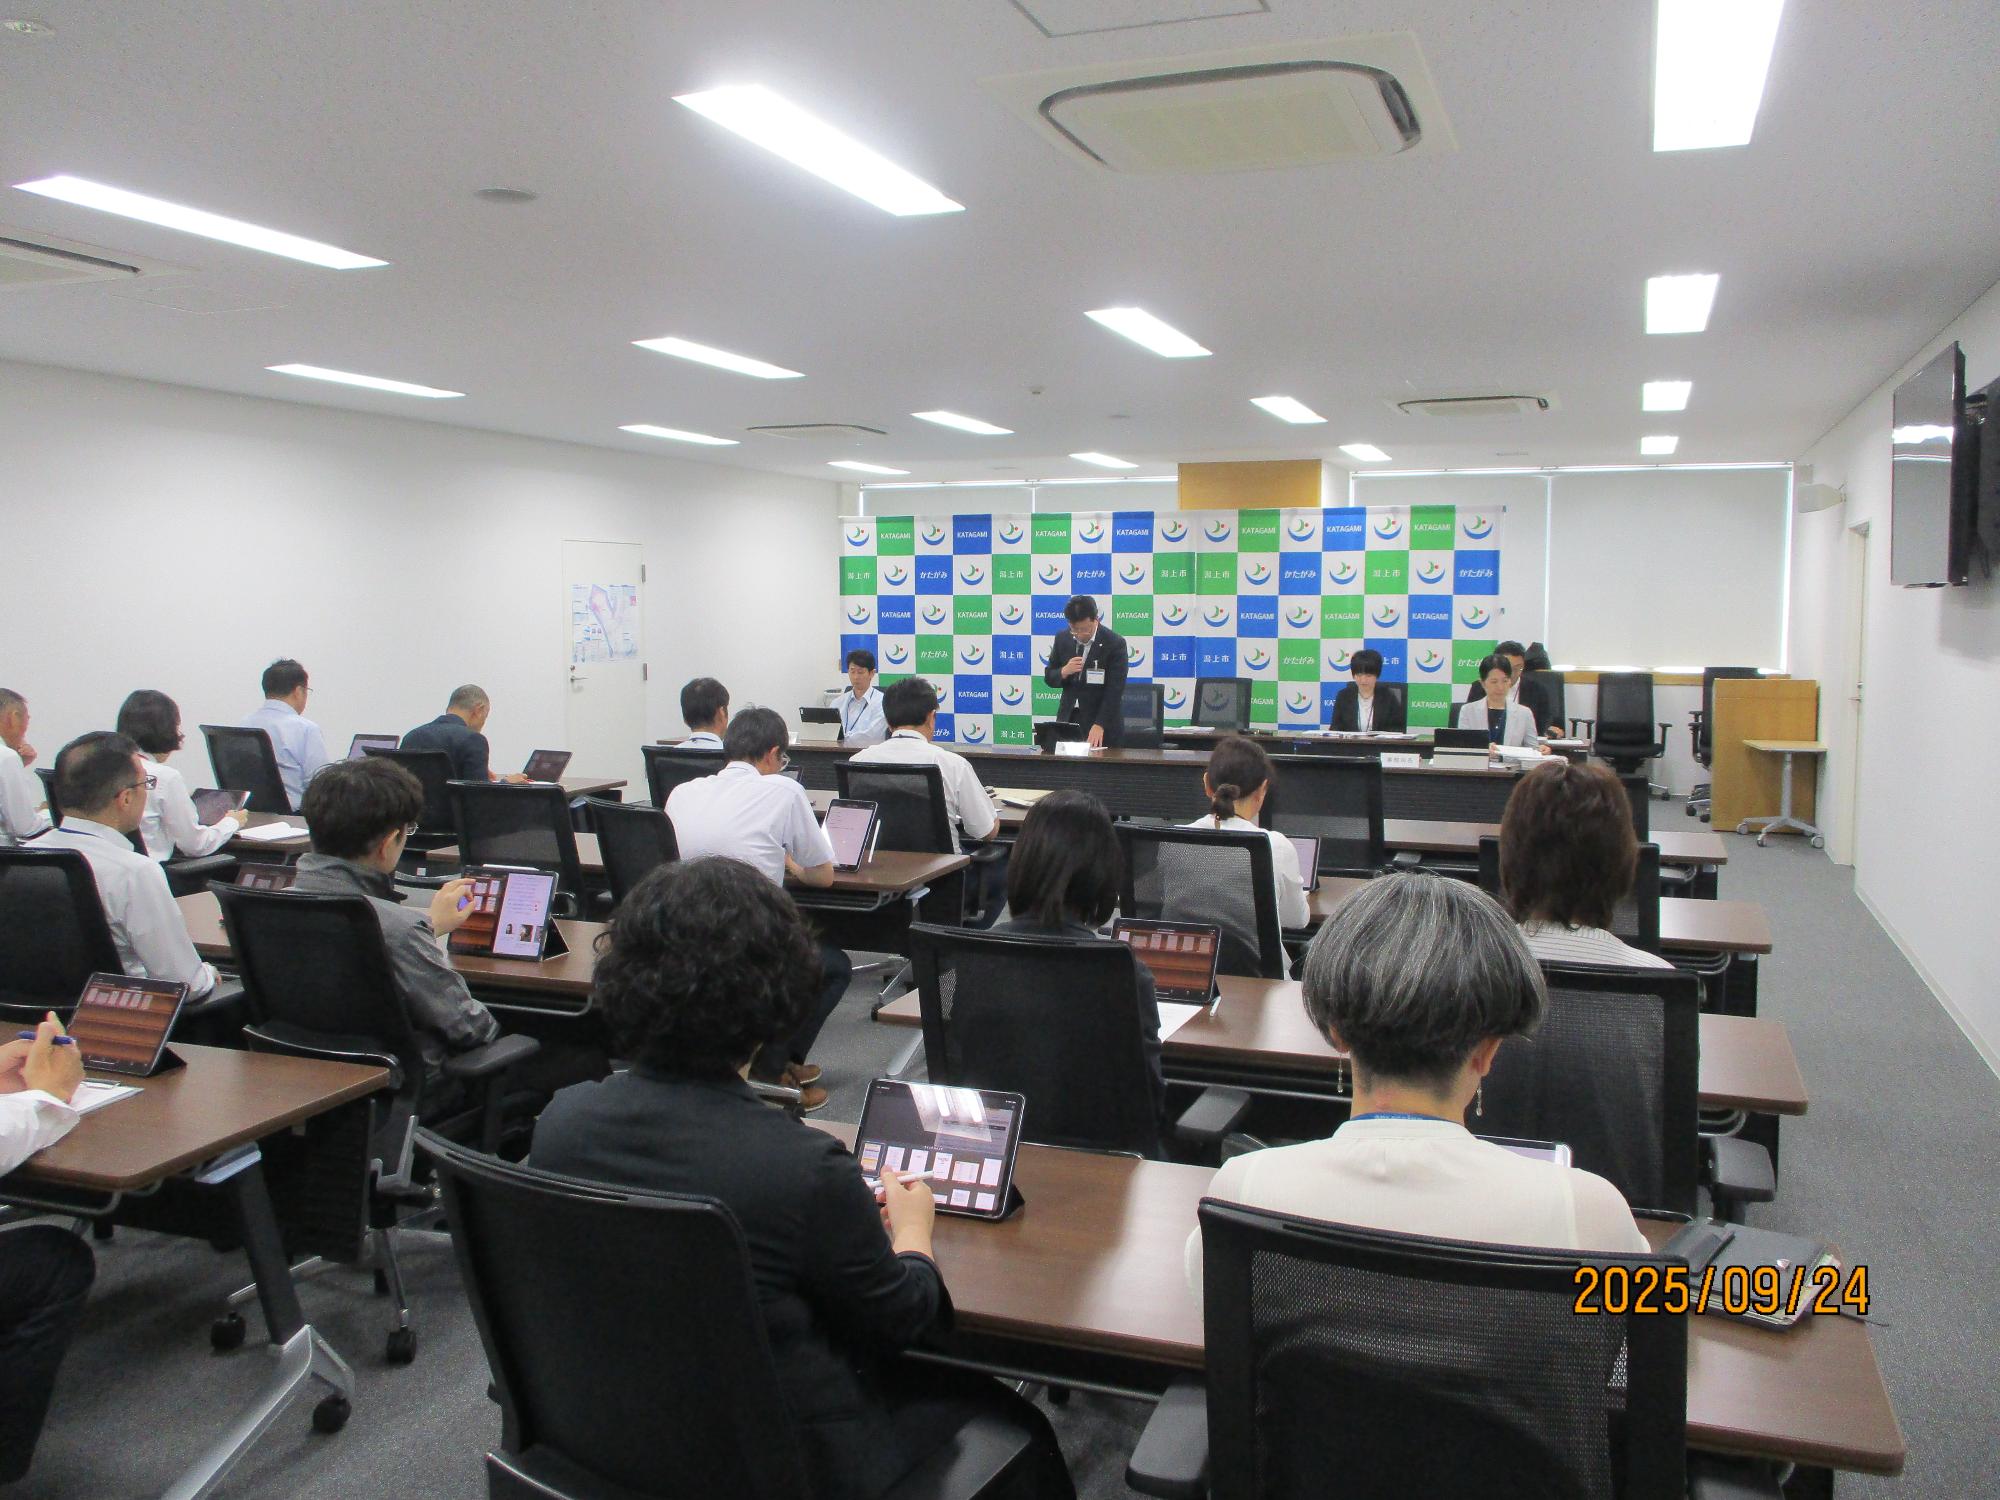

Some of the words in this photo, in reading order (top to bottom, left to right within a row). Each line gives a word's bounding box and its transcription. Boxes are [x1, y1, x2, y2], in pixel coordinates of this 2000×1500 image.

[1242, 527, 1276, 535] KATAGAMI
[1326, 525, 1362, 533] KATAGAMI
[1414, 523, 1451, 531] KATAGAMI
[957, 531, 988, 539] KATAGAMI
[1076, 570, 1106, 579] かたがみ
[1284, 570, 1317, 579] かたがみ
[1459, 569, 1494, 578] かたがみ
[1035, 611, 1065, 619] KATAGAM
[1240, 612, 1274, 620] KATAGAMI
[1382, 657, 1400, 665] 上市
